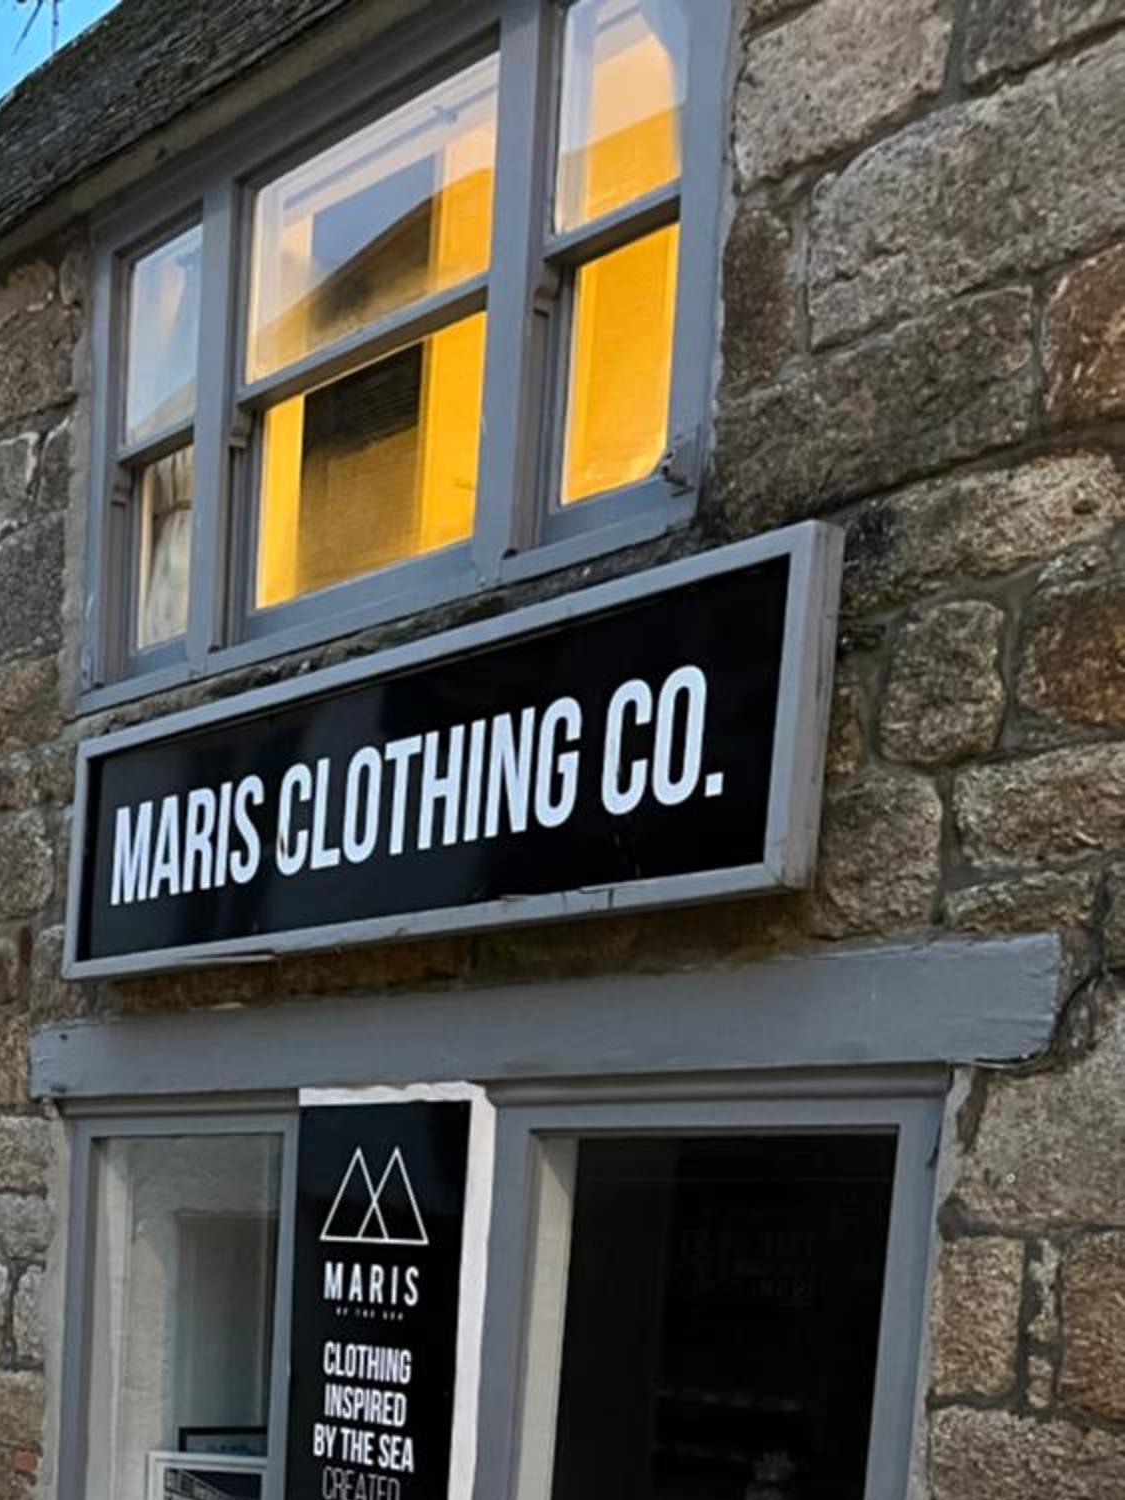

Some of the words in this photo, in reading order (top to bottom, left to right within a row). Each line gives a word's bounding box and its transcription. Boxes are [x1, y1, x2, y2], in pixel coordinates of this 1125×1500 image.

[110, 775, 264, 906] MARIS
[276, 697, 582, 876] CLOTHING
[601, 665, 724, 815] CO.
[323, 1261, 420, 1307] MARIS
[322, 1340, 412, 1385] CLOTHING
[323, 1382, 408, 1428] INSPIRED
[312, 1422, 338, 1459] BY
[339, 1426, 376, 1467] THE
[377, 1432, 415, 1473] SEA
